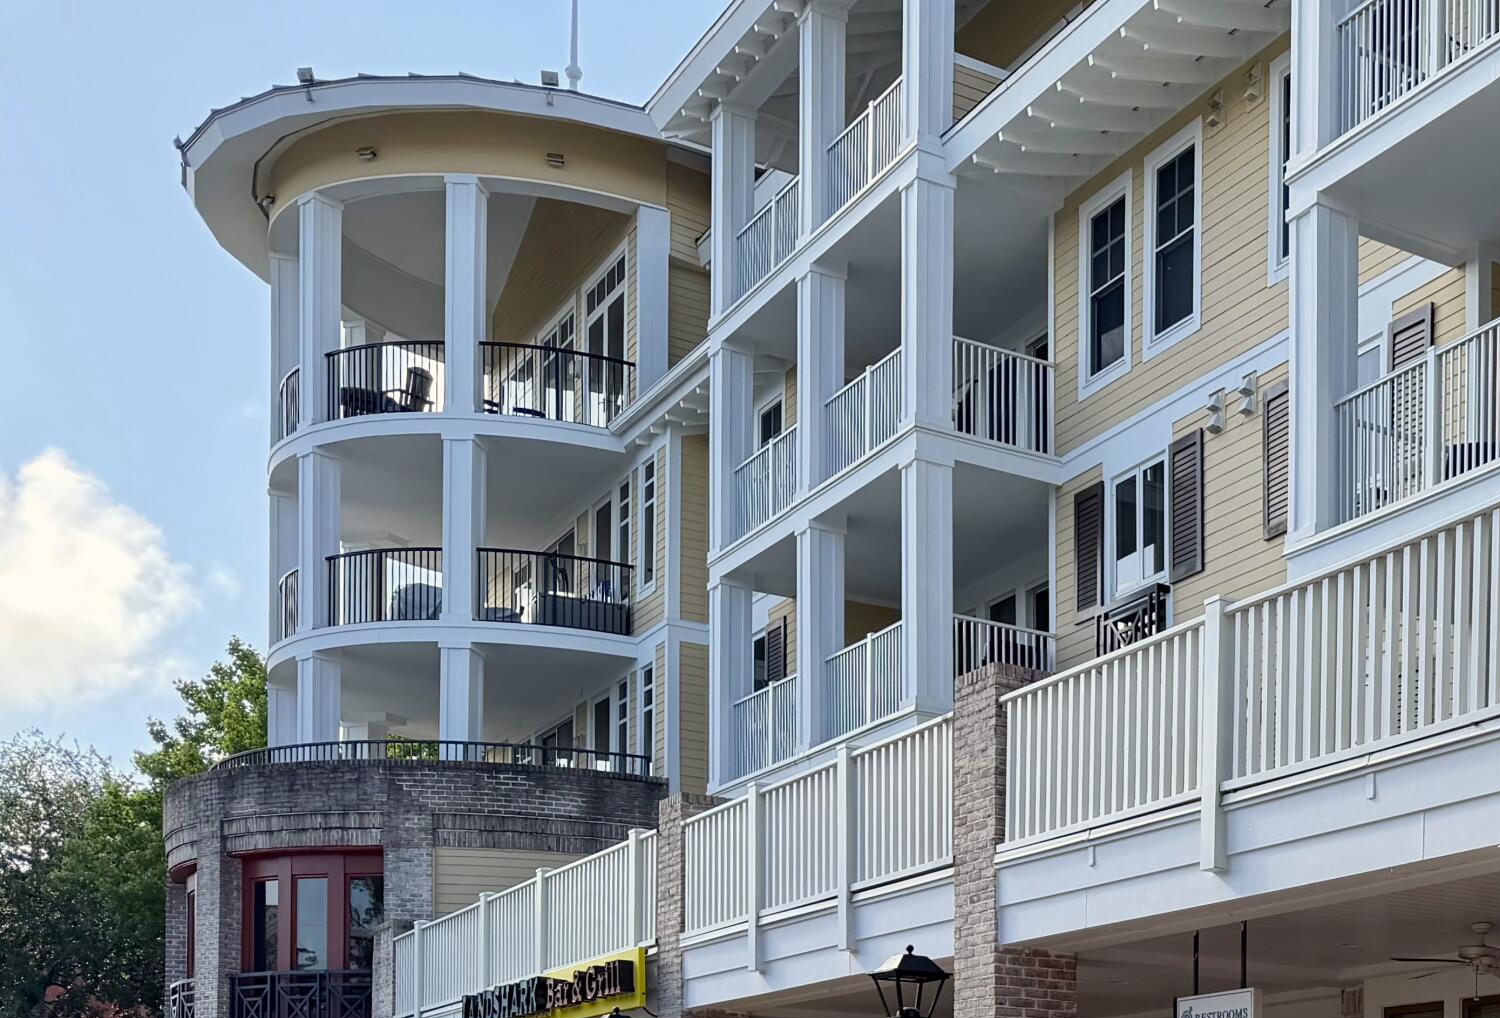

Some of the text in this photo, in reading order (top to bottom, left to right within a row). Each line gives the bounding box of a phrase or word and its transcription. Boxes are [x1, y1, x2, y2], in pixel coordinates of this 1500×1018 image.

[545, 979, 570, 1010] Bar
[571, 969, 583, 1004] &
[585, 960, 622, 1000] Grill
